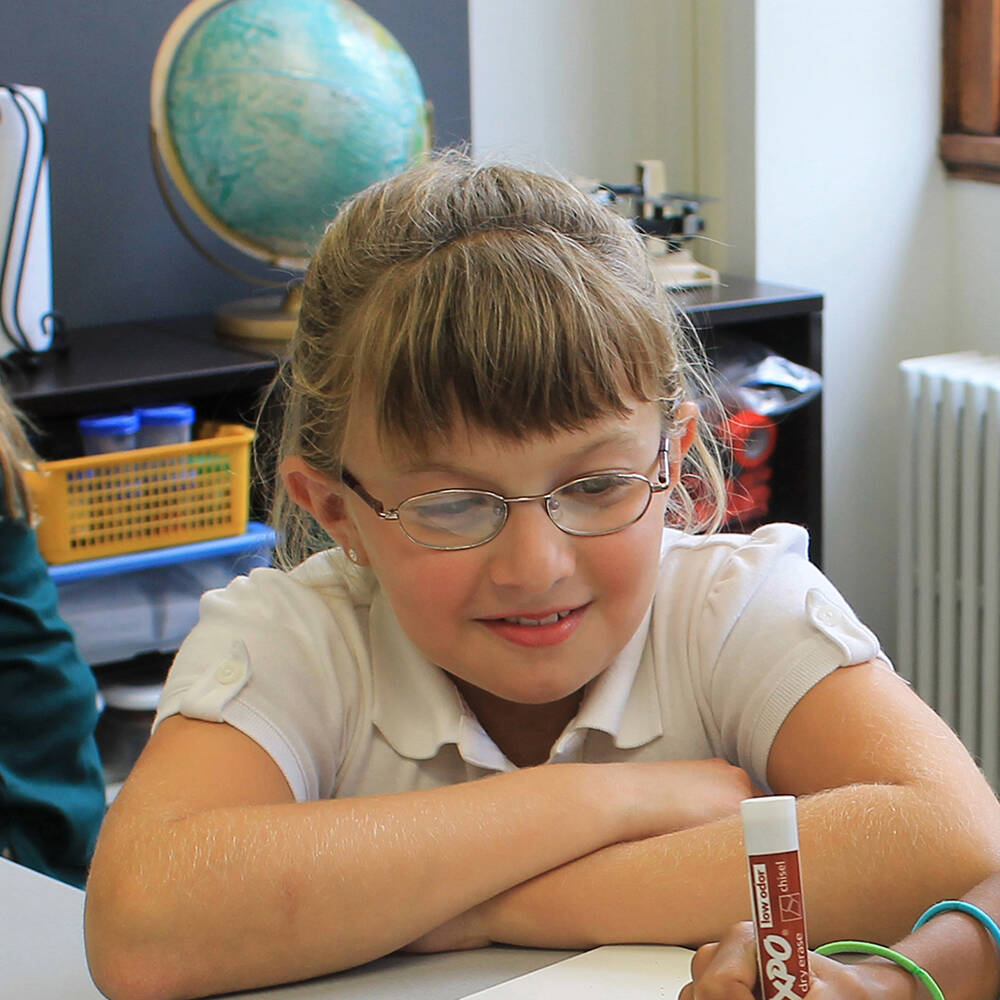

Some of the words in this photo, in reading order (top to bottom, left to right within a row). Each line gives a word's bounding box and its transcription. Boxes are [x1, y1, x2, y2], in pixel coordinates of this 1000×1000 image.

[757, 869, 768, 899] odor
[775, 861, 788, 892] chisel
[761, 902, 770, 924] low
[796, 933, 806, 967] erase
[799, 970, 809, 992] dry
